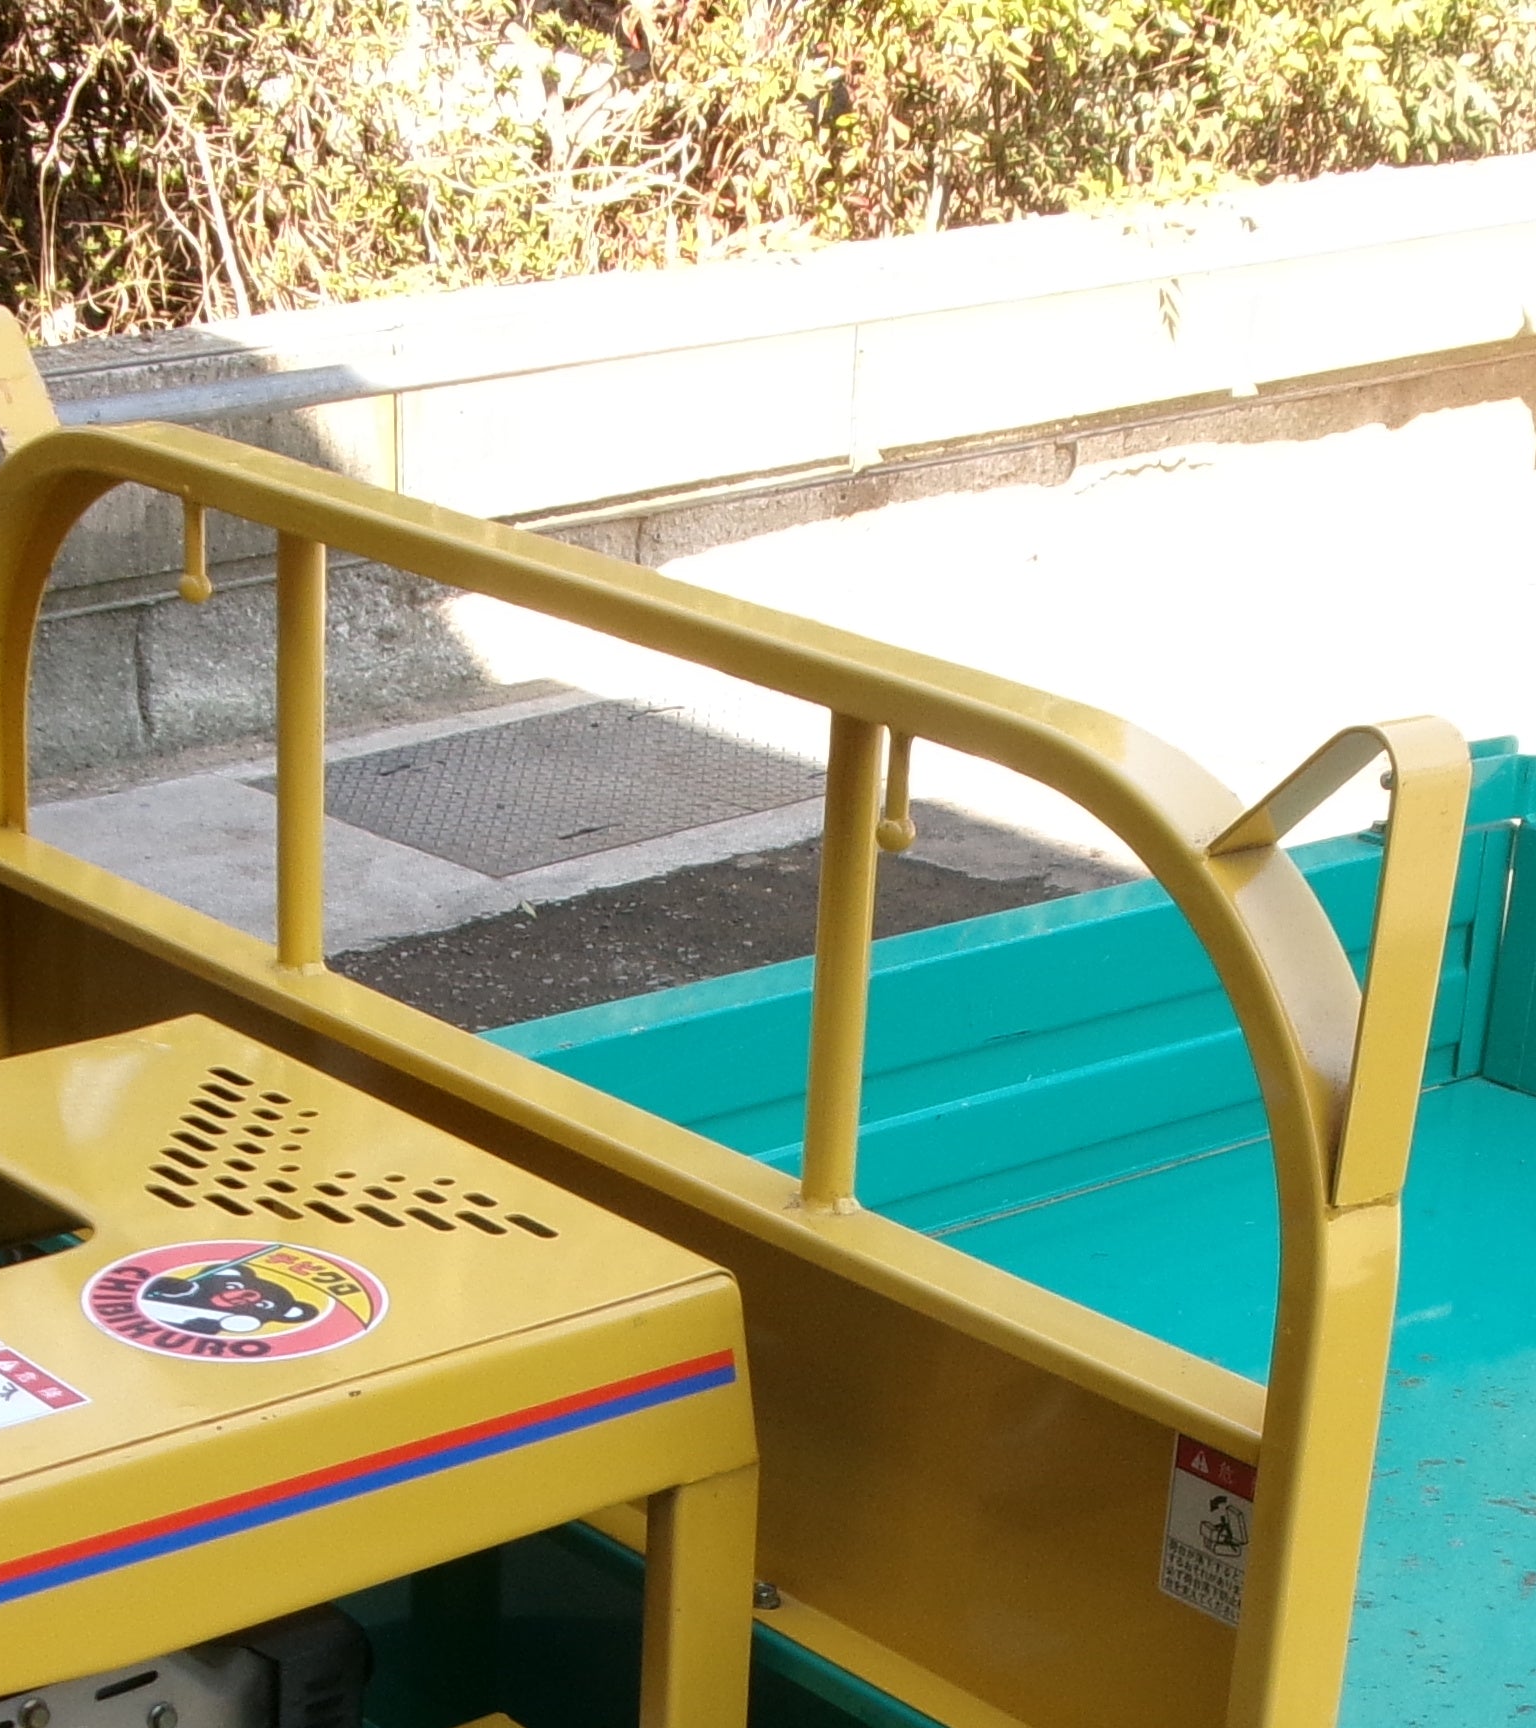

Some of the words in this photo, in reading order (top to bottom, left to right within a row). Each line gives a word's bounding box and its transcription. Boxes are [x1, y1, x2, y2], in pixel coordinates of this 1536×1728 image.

[264, 1252, 362, 1297] チビクロ
[92, 1265, 272, 1357] CHIBIKURO
